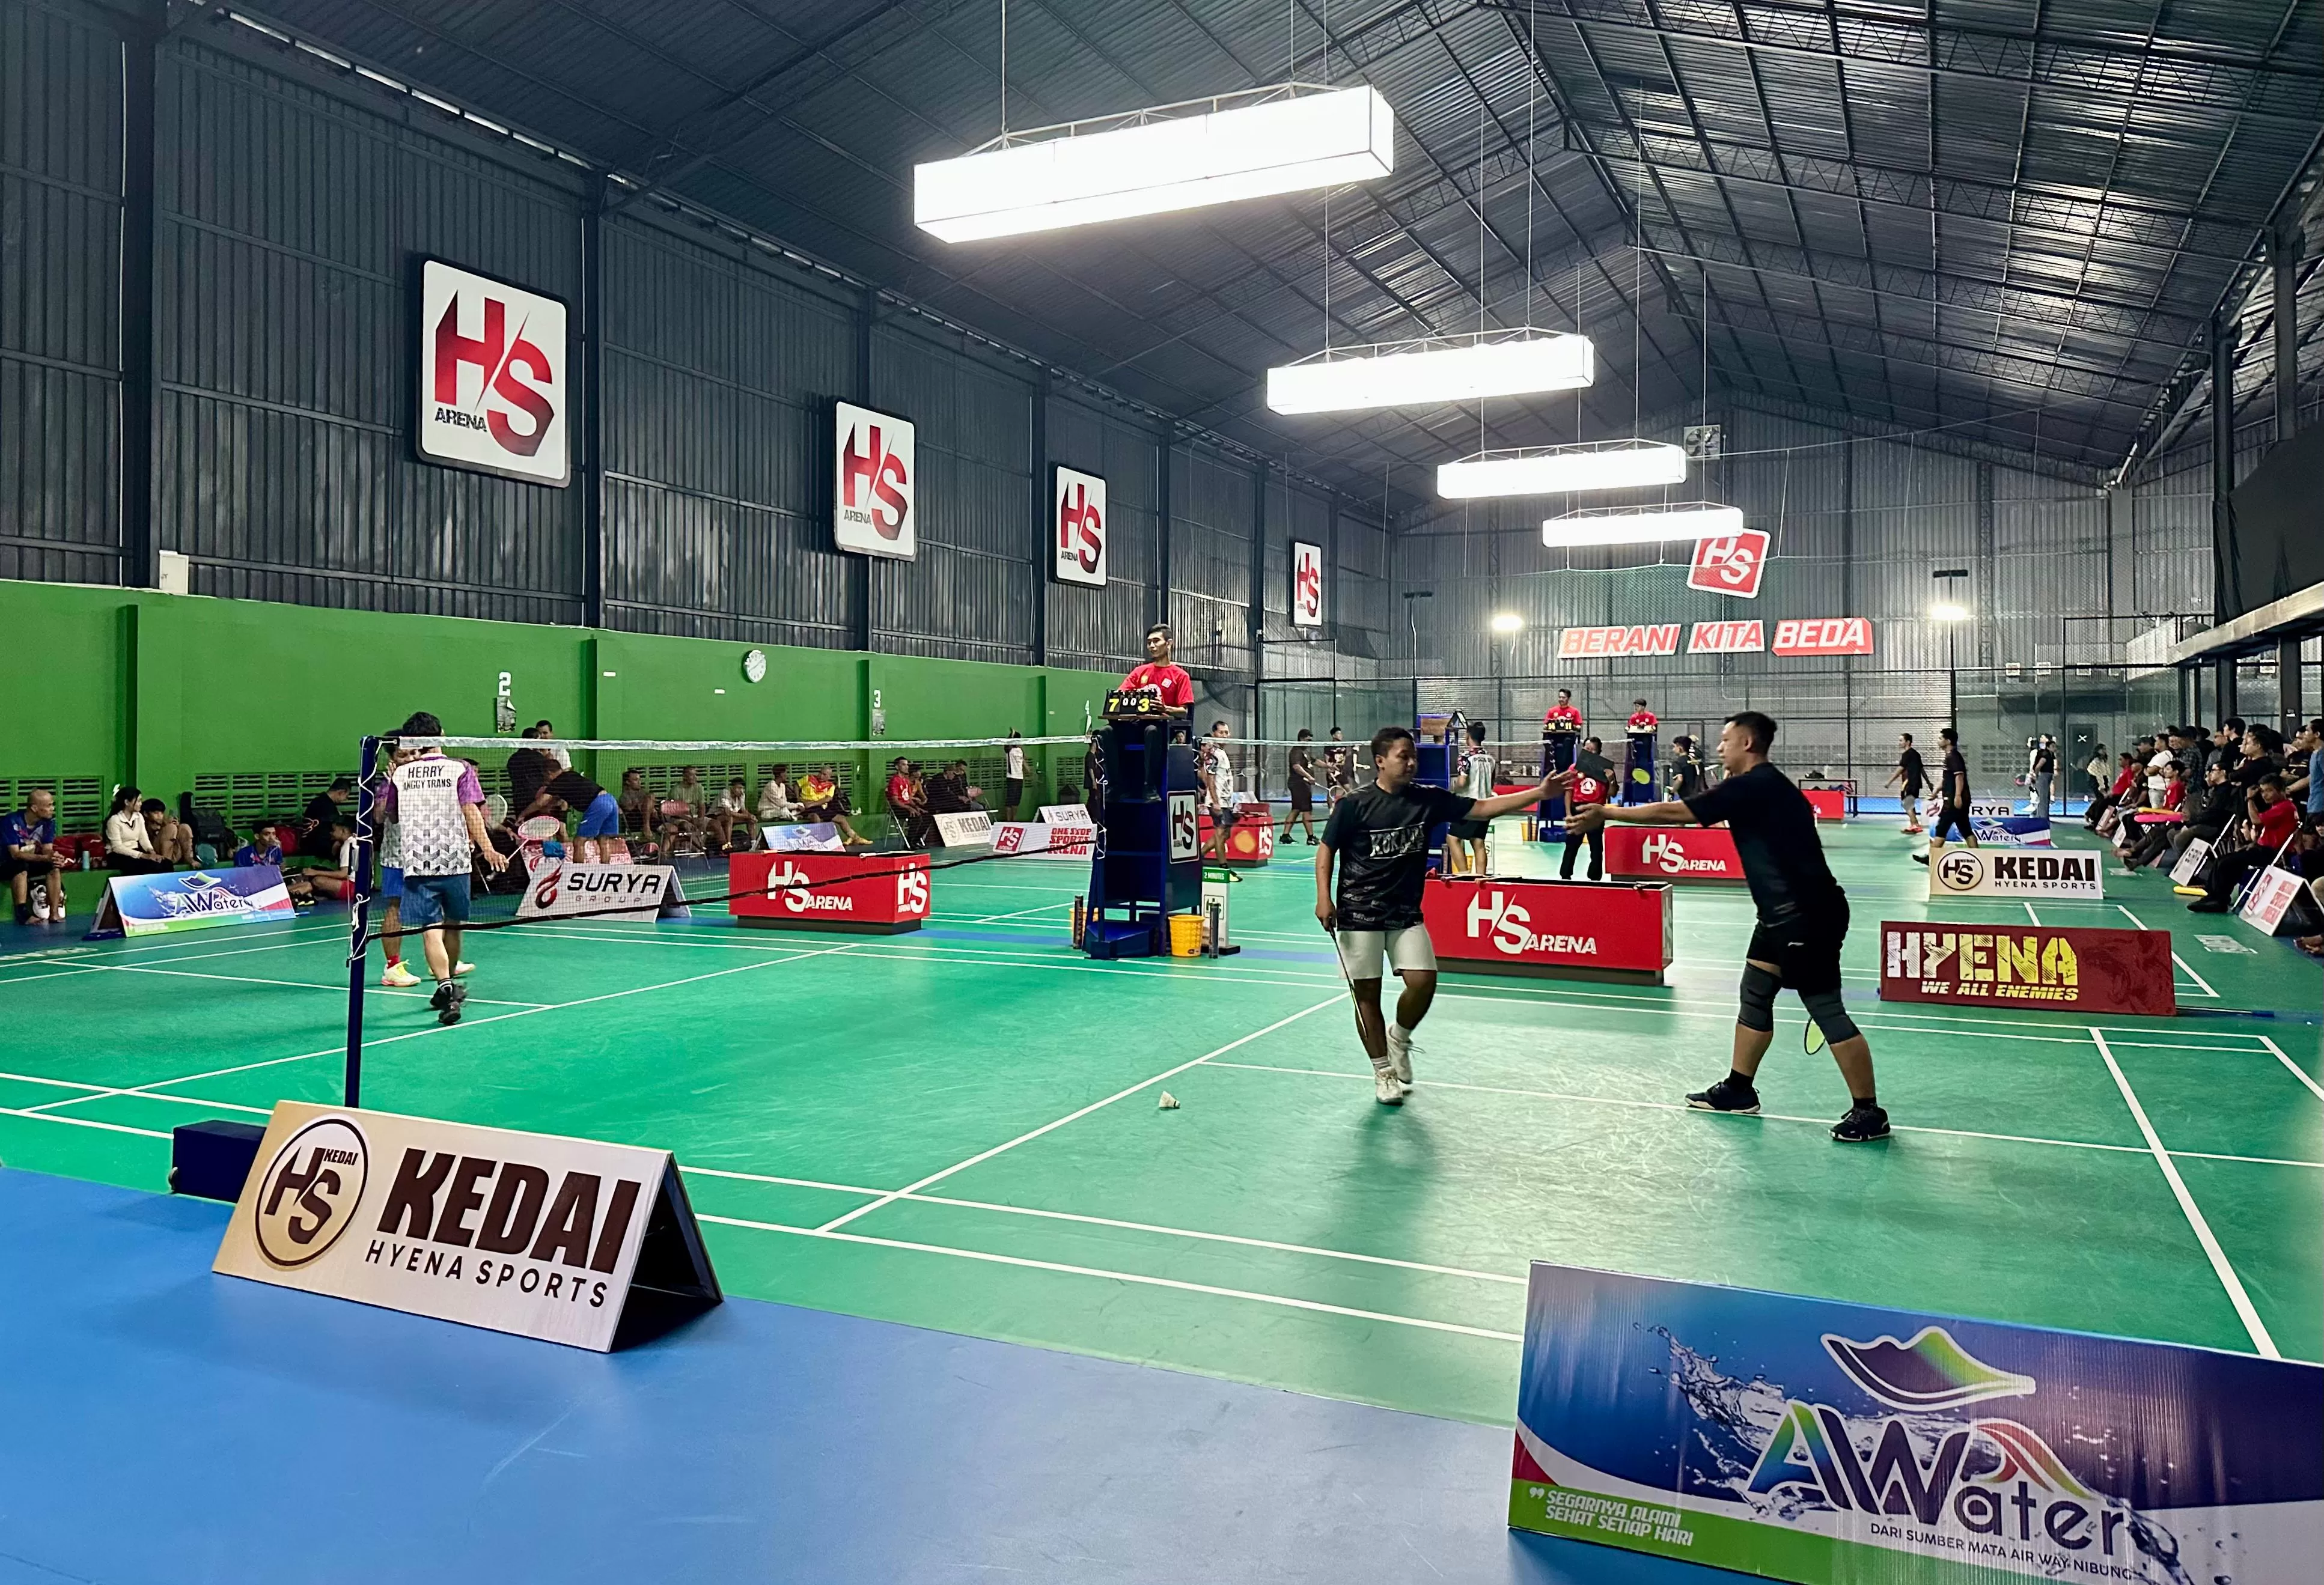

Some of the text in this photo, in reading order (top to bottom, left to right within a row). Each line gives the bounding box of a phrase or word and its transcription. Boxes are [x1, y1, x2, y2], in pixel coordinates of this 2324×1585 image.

[435, 289, 554, 457] HS
[435, 407, 487, 432] ARENA
[843, 422, 908, 541] HS
[844, 510, 871, 525] ARENA
[1061, 481, 1102, 574] HS
[1061, 550, 1078, 562] ARENA
[1702, 537, 1754, 585] HS
[1297, 552, 1319, 617] HS
[1563, 619, 1865, 654] BERANI KITA BEDA
[499, 672, 511, 696] 2
[874, 690, 881, 708] 3
[1109, 698, 1119, 712] 7
[1138, 698, 1150, 712] 3
[408, 765, 445, 779] HERRY
[427, 779, 451, 789] TRANS
[1055, 810, 1089, 821] SURYA
[1972, 806, 2010, 815] RYA
[957, 816, 991, 833] KEDAI
[1000, 828, 1020, 846] HS
[1172, 800, 1194, 850] HS
[1048, 845, 1087, 855] ARENA
[1049, 836, 1091, 844] SPORTS
[1259, 821, 1272, 856] HS
[1642, 833, 1684, 873] HS
[1680, 859, 1727, 871] ARENA
[1943, 859, 1974, 884] HS
[1995, 856, 2096, 881] KEDAI
[567, 872, 661, 894] SURYA
[767, 860, 811, 913] HS
[897, 862, 928, 914] HS
[2043, 881, 2096, 890] SPORTS
[575, 895, 642, 904] GROUP
[805, 896, 853, 911] ARENA
[1466, 890, 1532, 954] HS
[1523, 934, 1597, 954] ARENA
[1886, 931, 2078, 985] HYENA
[1921, 981, 2079, 1001] WE ALL ENEMIES
[323, 1148, 359, 1166] KEDAI
[263, 1146, 341, 1244] HS
[376, 1147, 641, 1275] KEDAI
[365, 1240, 608, 1308] HYENA SPORTS
[1746, 1403, 2124, 1556] AWater
[1546, 1490, 1682, 1528] SEGARNYA ALAMI
[1545, 1505, 1694, 1546] SEHAT SETIAP HARI
[1870, 1523, 2132, 1581] DARI SUMBER MATA AIR WAY NIBUNG
